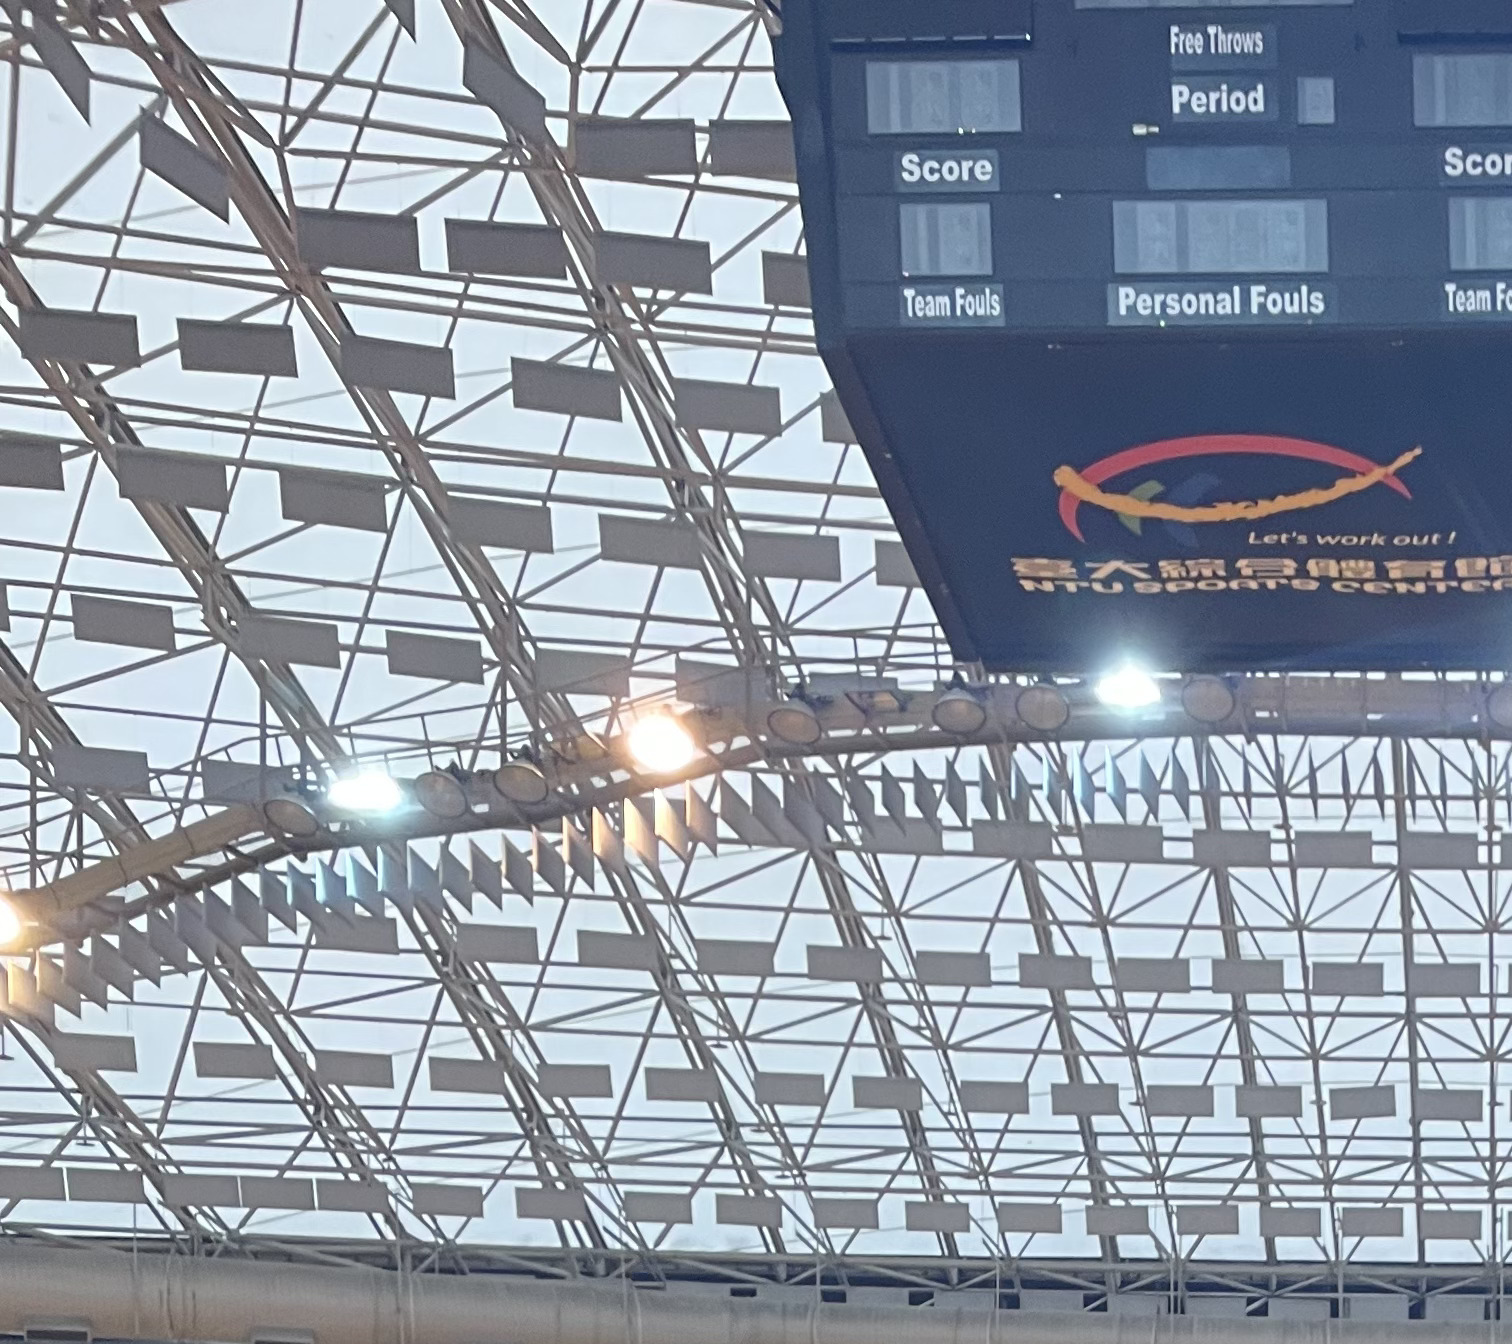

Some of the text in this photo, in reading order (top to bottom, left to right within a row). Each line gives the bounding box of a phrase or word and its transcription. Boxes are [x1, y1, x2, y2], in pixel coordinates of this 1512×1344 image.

[1169, 25, 1264, 54] Free Throws
[1171, 83, 1265, 114] Period
[901, 153, 993, 182] Score
[903, 287, 1001, 317] Team Fouls
[1118, 284, 1325, 316] Personal Fouls
[1444, 282, 1491, 312] Team
[1249, 531, 1308, 545] Let's
[1316, 531, 1385, 546] work
[1019, 578, 1124, 594] NTU
